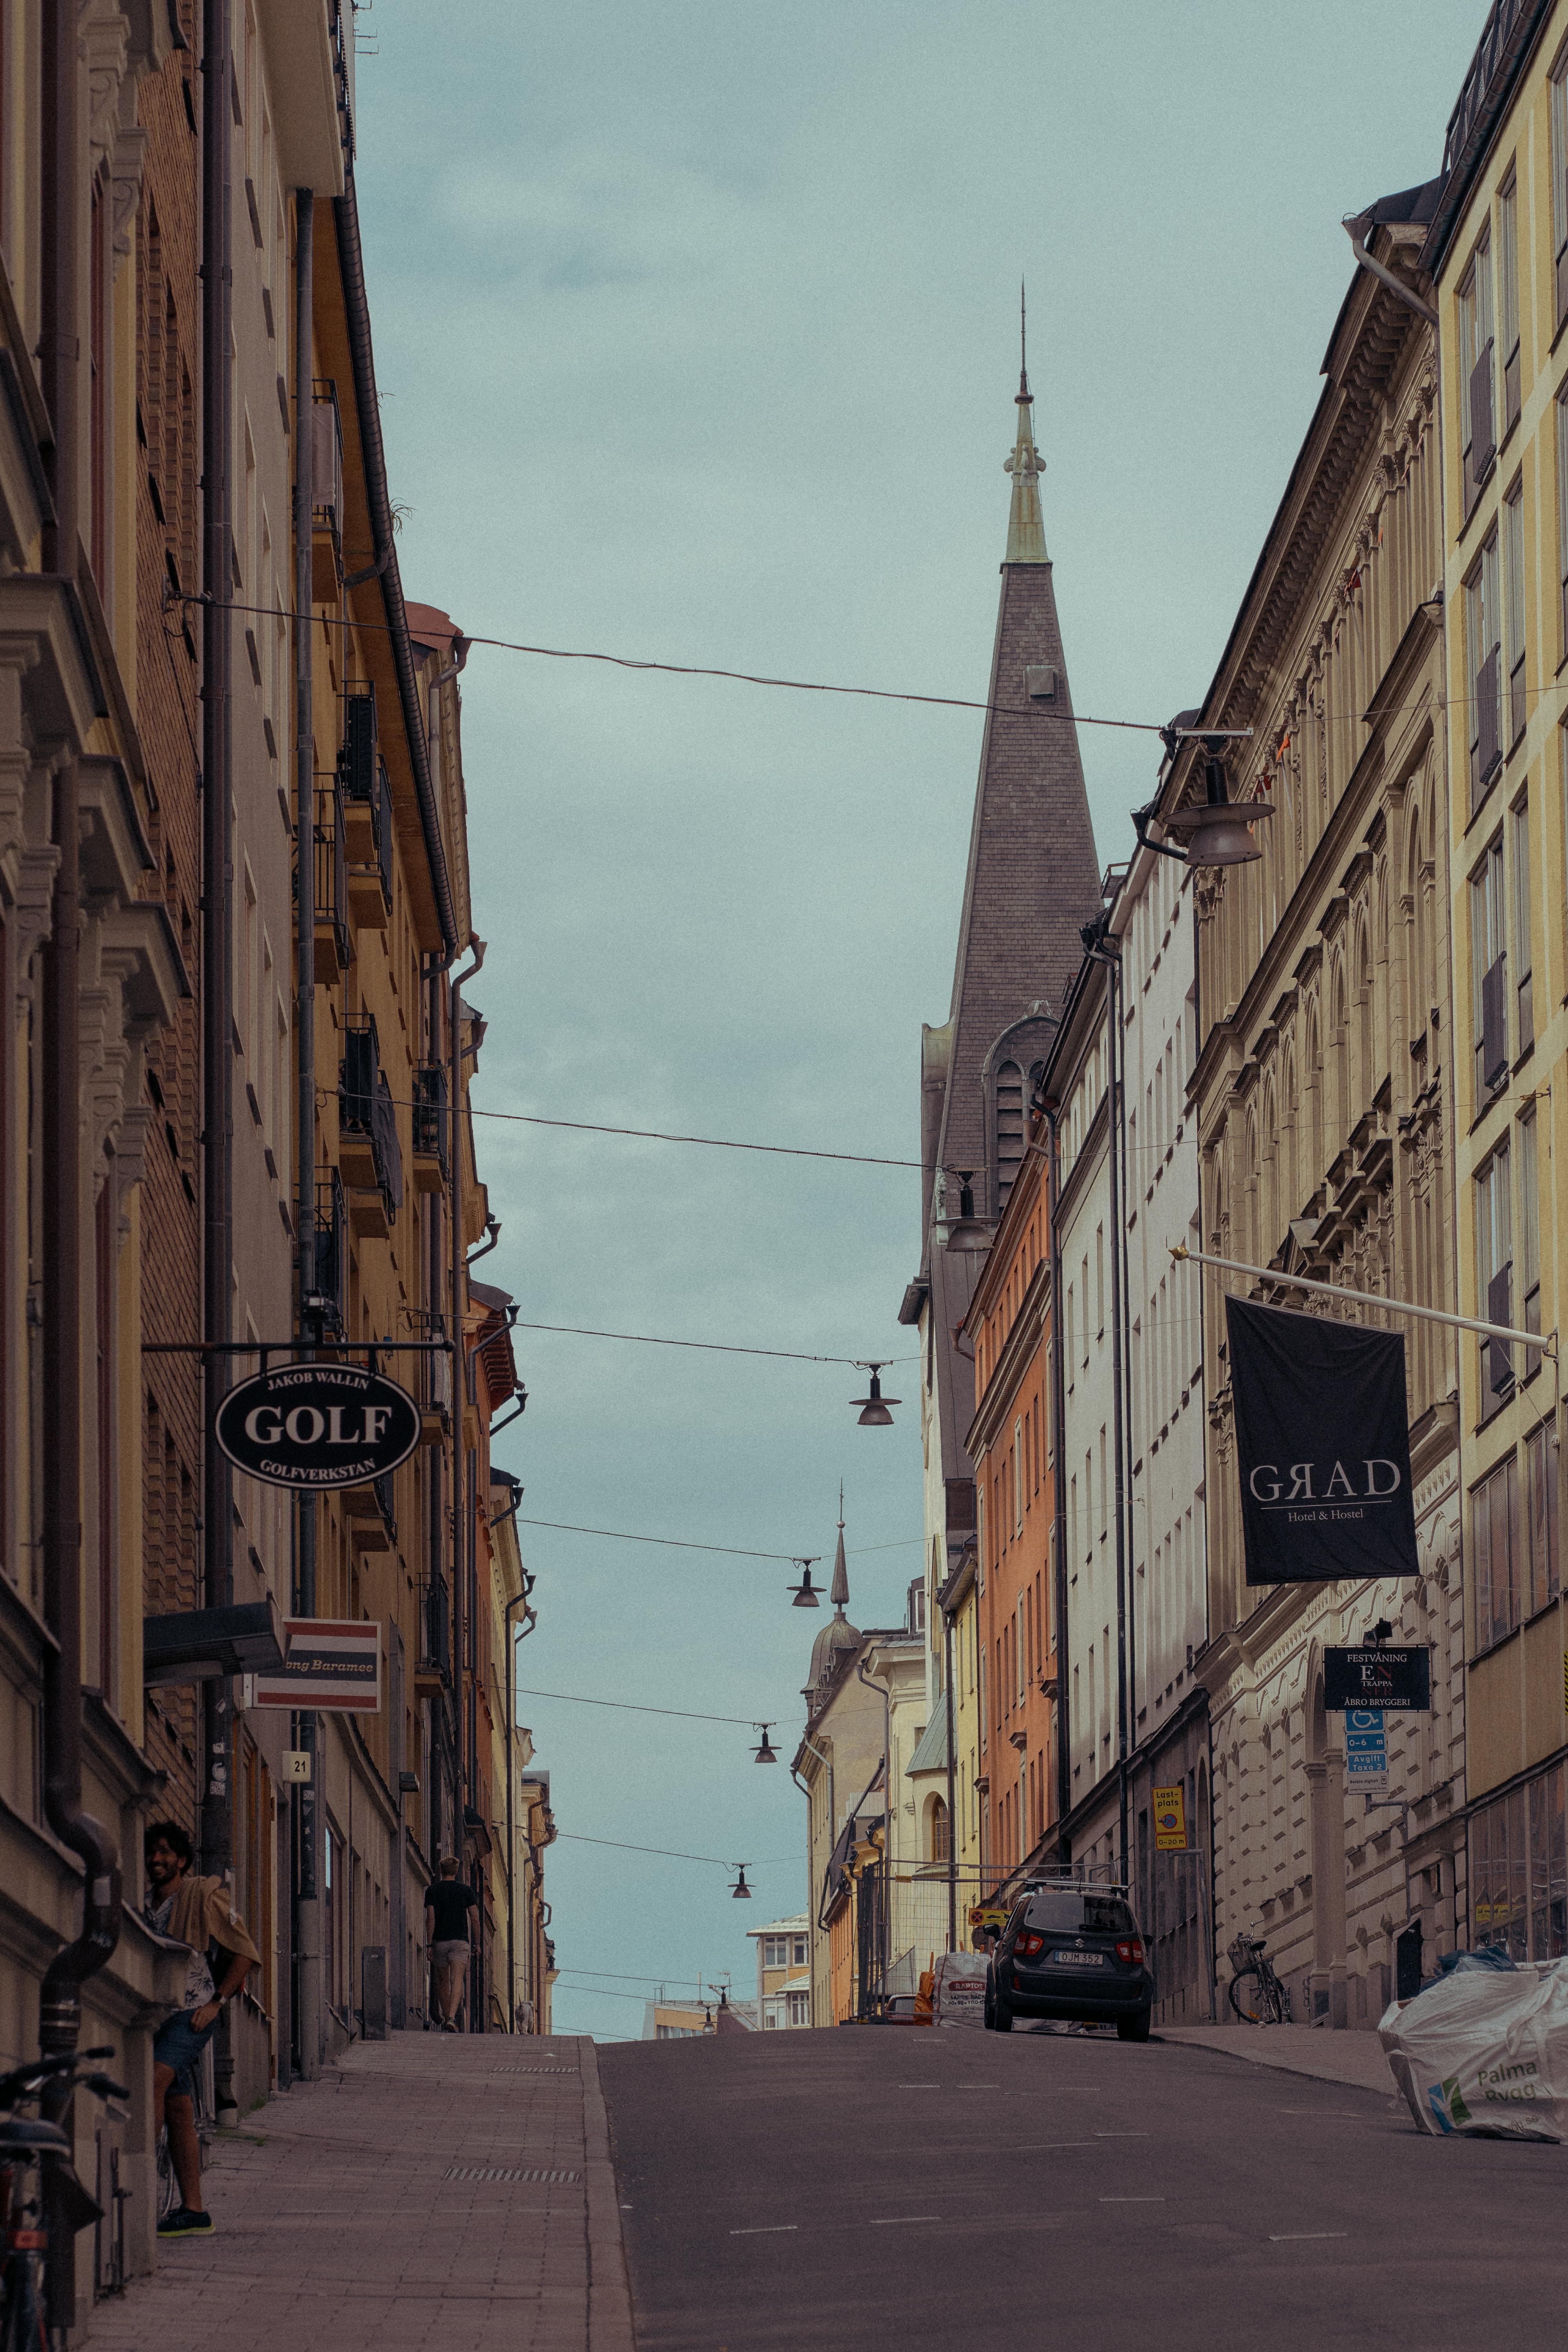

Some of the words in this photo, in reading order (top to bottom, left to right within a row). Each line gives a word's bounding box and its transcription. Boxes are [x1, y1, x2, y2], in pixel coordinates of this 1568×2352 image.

[268, 1372, 313, 1391] JAKOB
[315, 1372, 370, 1390] WALLIN
[245, 1406, 392, 1444] GOLF
[260, 1458, 376, 1481] GOLFVERKSTAN
[1288, 1511, 1316, 1522] Hotel
[1318, 1511, 1328, 1520] &
[1332, 1508, 1364, 1519] Hostel
[1347, 1652, 1407, 1662] FESTVÅNING
[311, 1659, 373, 1672] Baramee
[1360, 1666, 1393, 1680] EN
[1361, 1687, 1393, 1696] NER
[1344, 1697, 1367, 1706] ÅBRO
[1354, 1755, 1380, 1764] Avgift
[295, 1760, 305, 1772] 21
[1158, 1800, 1179, 1808] plats
[1062, 1953, 1079, 1962] OJM
[1082, 1954, 1099, 1963] 352
[1478, 2062, 1537, 2087] Palma
